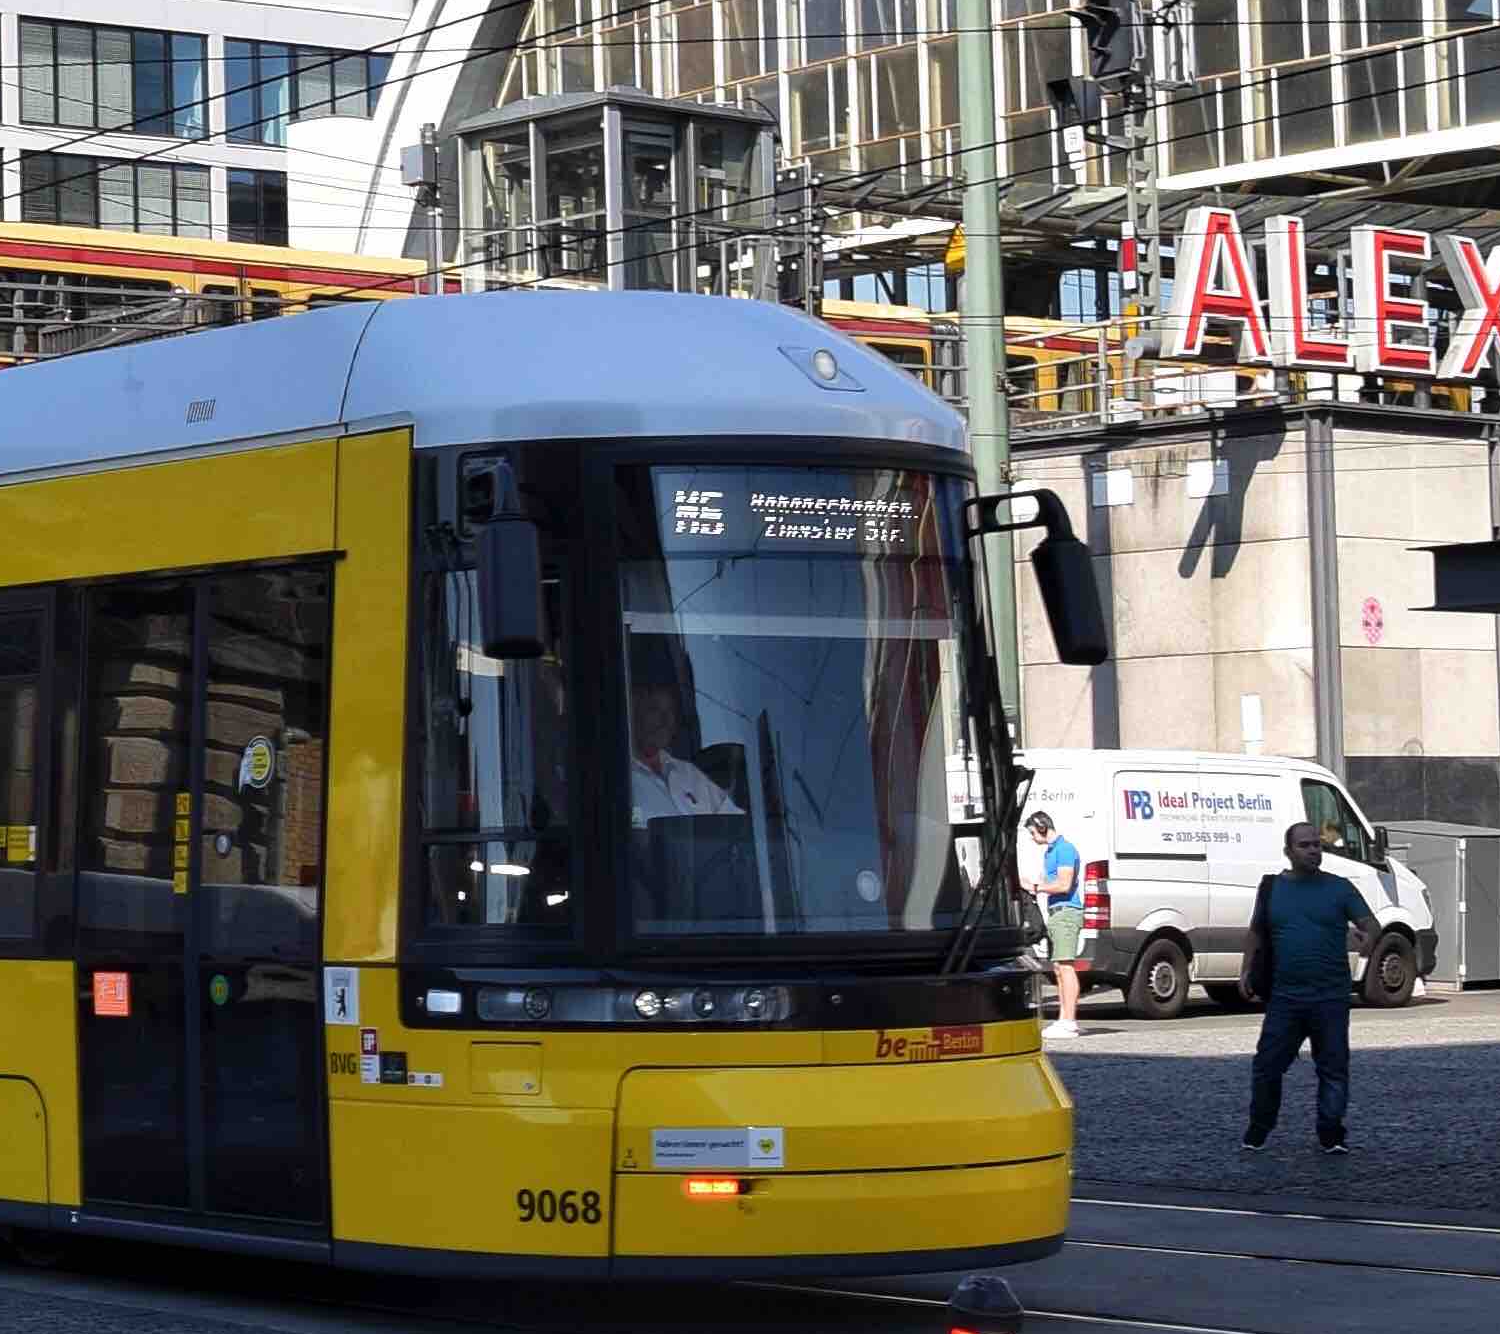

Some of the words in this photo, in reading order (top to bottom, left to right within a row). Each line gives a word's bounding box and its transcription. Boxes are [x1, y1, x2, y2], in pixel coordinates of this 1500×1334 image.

[1123, 789, 1154, 820] IPB
[1158, 791, 1188, 809] Ideal
[1192, 792, 1235, 814] Project
[1237, 793, 1272, 811] Berlin
[876, 1029, 906, 1059] be
[943, 1032, 979, 1051] Berlin
[330, 1051, 357, 1074] BVG
[517, 1188, 602, 1225] 9068
